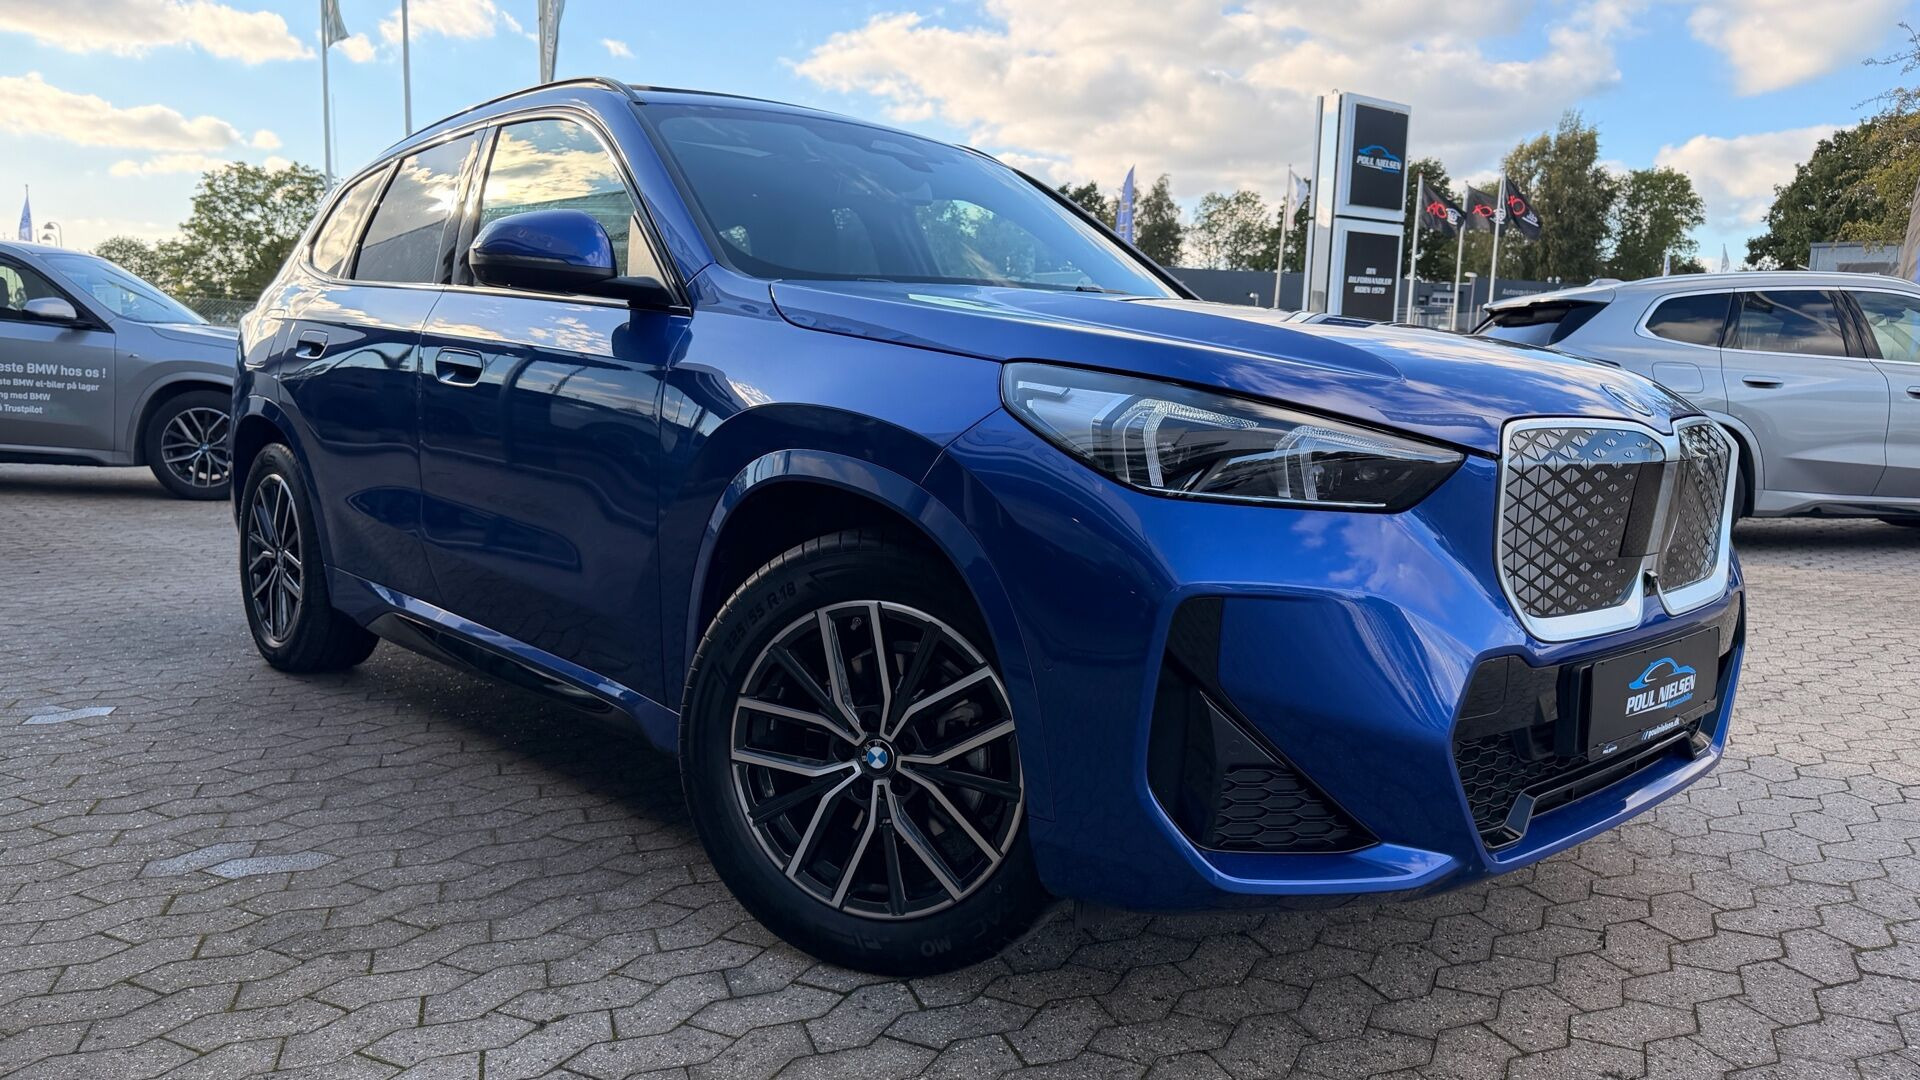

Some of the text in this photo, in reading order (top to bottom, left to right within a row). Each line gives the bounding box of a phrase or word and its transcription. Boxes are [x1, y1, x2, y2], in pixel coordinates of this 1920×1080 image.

[1375, 158, 1402, 170] NIELSEN
[26, 362, 58, 375] BMW
[60, 364, 82, 377] hos
[84, 368, 100, 378] os
[102, 367, 106, 379] !
[12, 378, 34, 387] BMW
[66, 381, 77, 391] på
[78, 382, 100, 392] lager
[10, 392, 28, 400] med
[29, 392, 51, 401] BMW
[4, 403, 43, 414] Trustpilot
[1625, 674, 1697, 715] POUL NIELSEN
